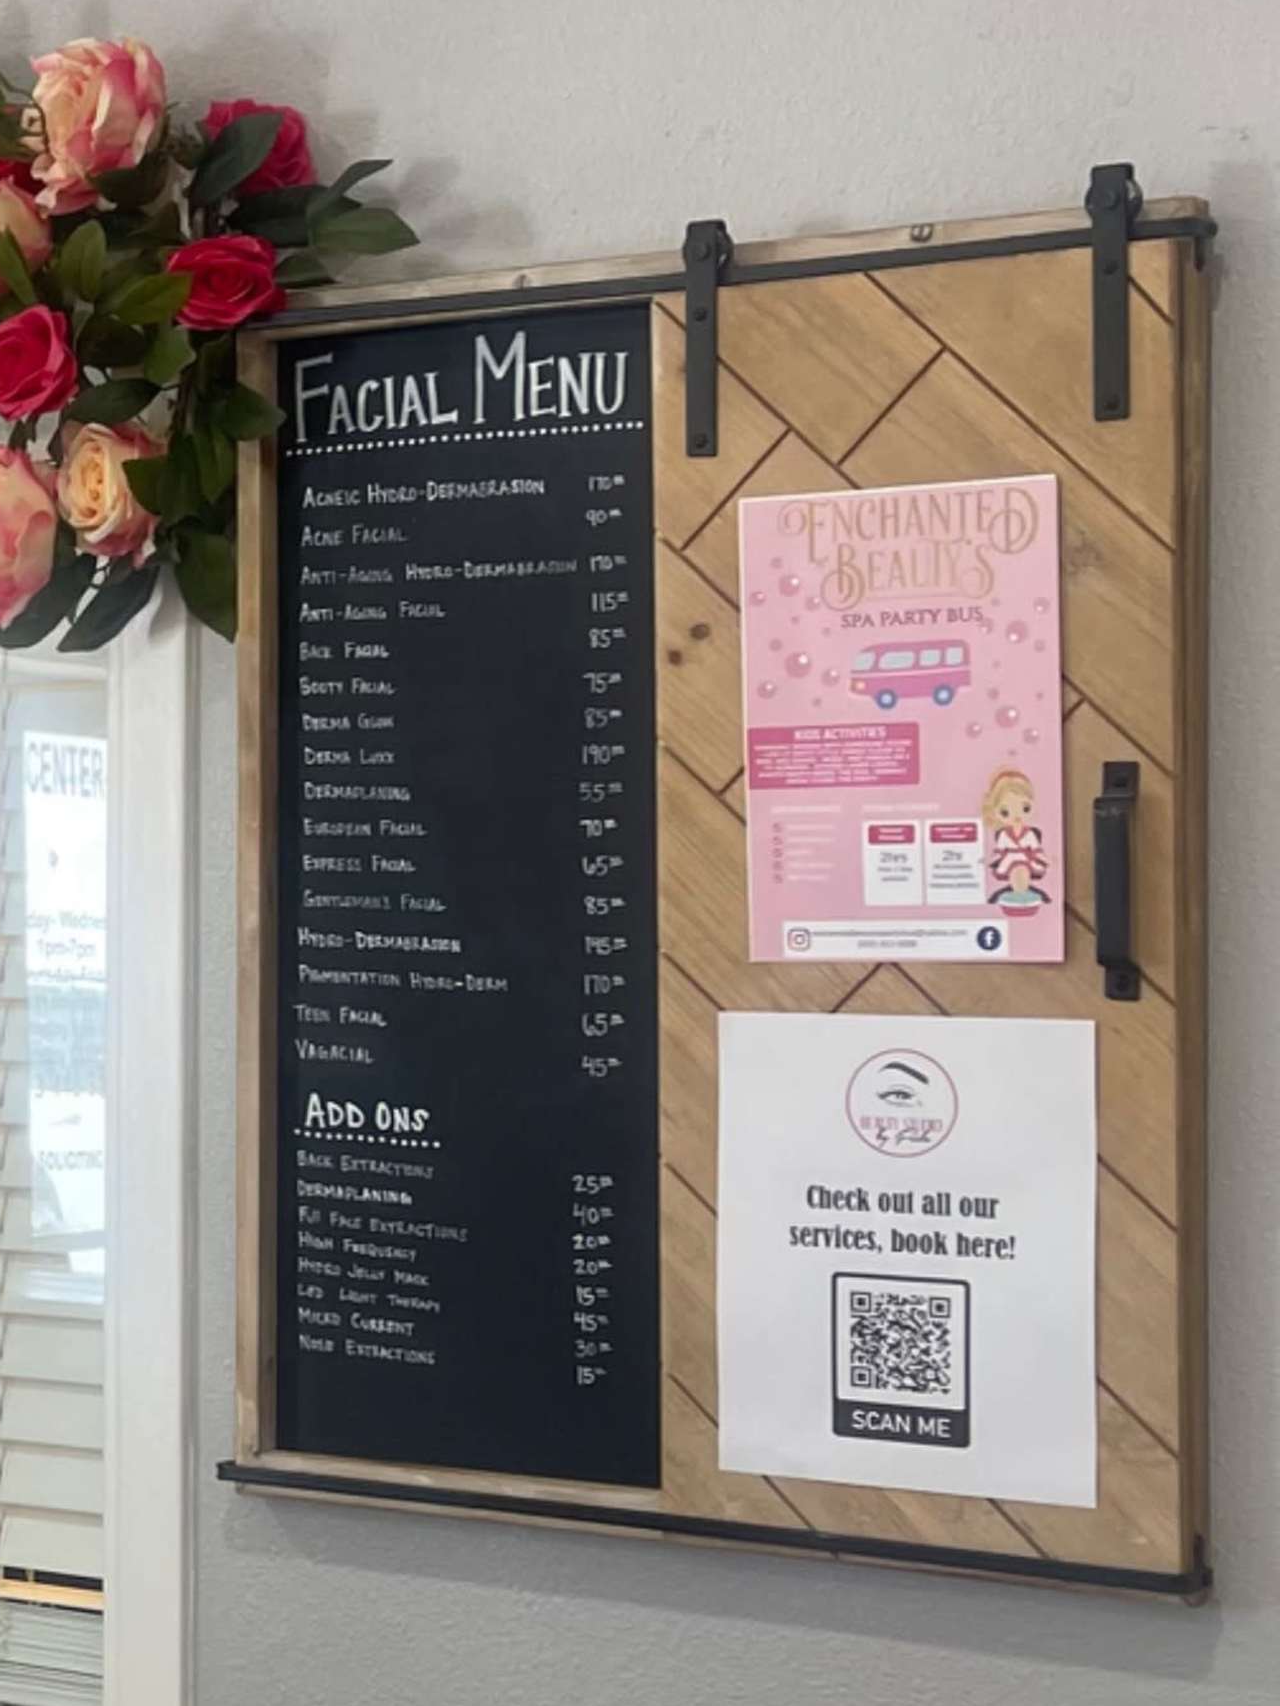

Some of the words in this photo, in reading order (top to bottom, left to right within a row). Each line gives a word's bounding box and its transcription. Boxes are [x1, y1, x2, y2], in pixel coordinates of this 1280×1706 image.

[294, 352, 459, 443] FACIAL
[473, 331, 628, 424] MENU
[352, 524, 408, 543] FACIAL
[778, 487, 1039, 566] ENCHANTED
[400, 601, 446, 618] FACIAL
[841, 613, 874, 629] SPA
[881, 609, 942, 627] PARTY
[947, 607, 983, 623] BUS
[345, 642, 390, 659] FACIAL
[352, 677, 396, 695] FACIAL
[28, 743, 105, 799] CENTER
[380, 820, 428, 836] FACIAL
[372, 855, 416, 873] FACIAL
[401, 893, 447, 912] FACIAL
[340, 1006, 387, 1026] FACIAL
[305, 1093, 364, 1129] ADD
[375, 1101, 429, 1133] ONS
[806, 1184, 870, 1213] Check
[878, 1191, 913, 1215] out
[922, 1191, 952, 1216] all
[959, 1199, 999, 1220] our
[789, 1224, 882, 1255] services,
[890, 1228, 949, 1256] book
[957, 1232, 1016, 1260] here!
[851, 1409, 911, 1436] SCAN
[918, 1416, 952, 1439] ME
